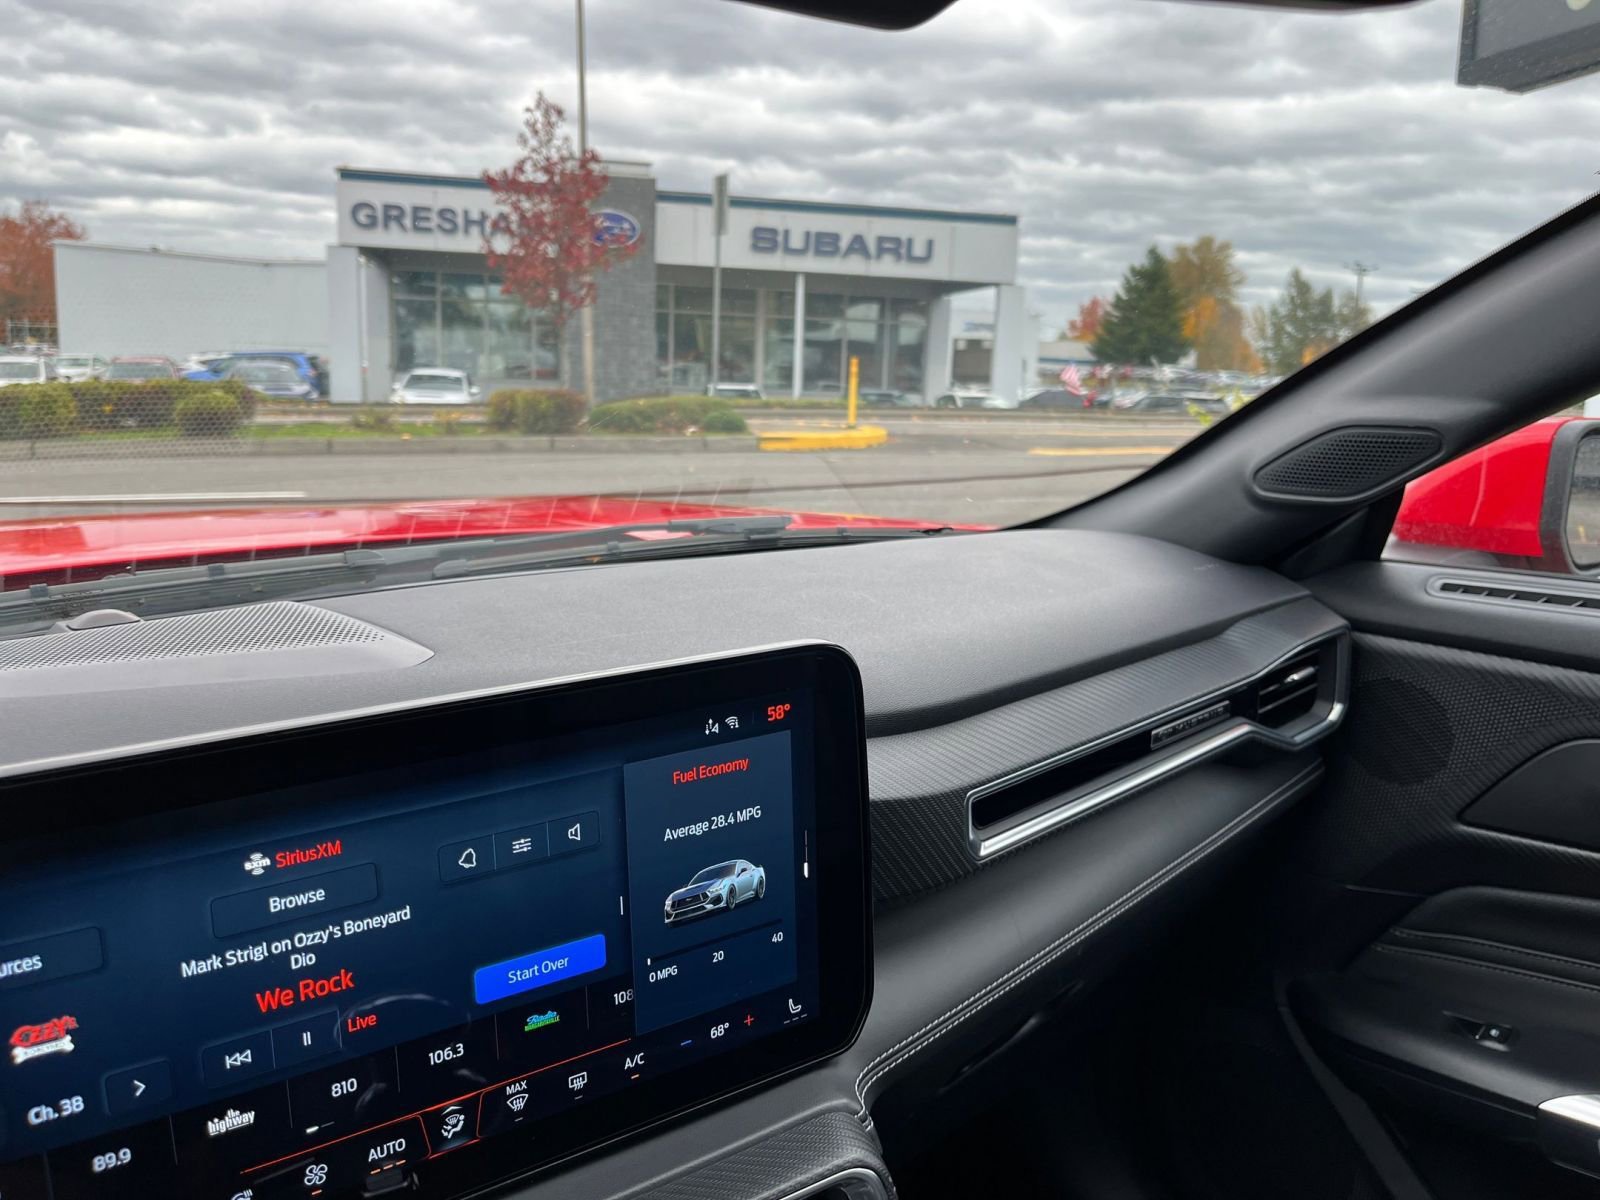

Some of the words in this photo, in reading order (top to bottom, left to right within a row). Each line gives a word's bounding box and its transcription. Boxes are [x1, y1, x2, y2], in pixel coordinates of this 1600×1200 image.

[350, 201, 518, 238] GRESHA
[751, 225, 934, 265] SUBARU
[767, 703, 791, 722] 58°
[672, 768, 698, 785] Fuel
[700, 758, 749, 780] Economy
[664, 820, 710, 842] Average
[711, 812, 735, 831] 28.4
[736, 805, 762, 823] MPG
[274, 840, 342, 868] SiriusXM
[269, 888, 326, 913] Browse
[181, 953, 223, 978] Mark
[225, 940, 269, 968] Strigl
[271, 937, 293, 954] on
[294, 925, 341, 949] Ozzy's
[344, 905, 411, 935] Boneyard
[771, 931, 784, 943] 40
[291, 952, 316, 970] Dio
[712, 950, 725, 963] 20
[508, 964, 540, 984] Start
[541, 956, 569, 975] Over
[649, 972, 656, 983] 0
[657, 965, 678, 981] MPG
[255, 987, 294, 1013] We
[299, 968, 355, 1002] Rock
[347, 1014, 377, 1033] Live
[710, 1022, 730, 1039] 68°
[428, 1043, 465, 1066] 106.3
[624, 1053, 645, 1070] A/C
[331, 1078, 358, 1098] 810
[506, 1080, 528, 1096] MAX
[27, 1104, 59, 1126] Ch.
[59, 1095, 85, 1117] 38
[208, 1110, 256, 1136] highway
[227, 1108, 240, 1119] the
[92, 1148, 132, 1173] 89.9
[367, 1138, 406, 1163] AUTO
